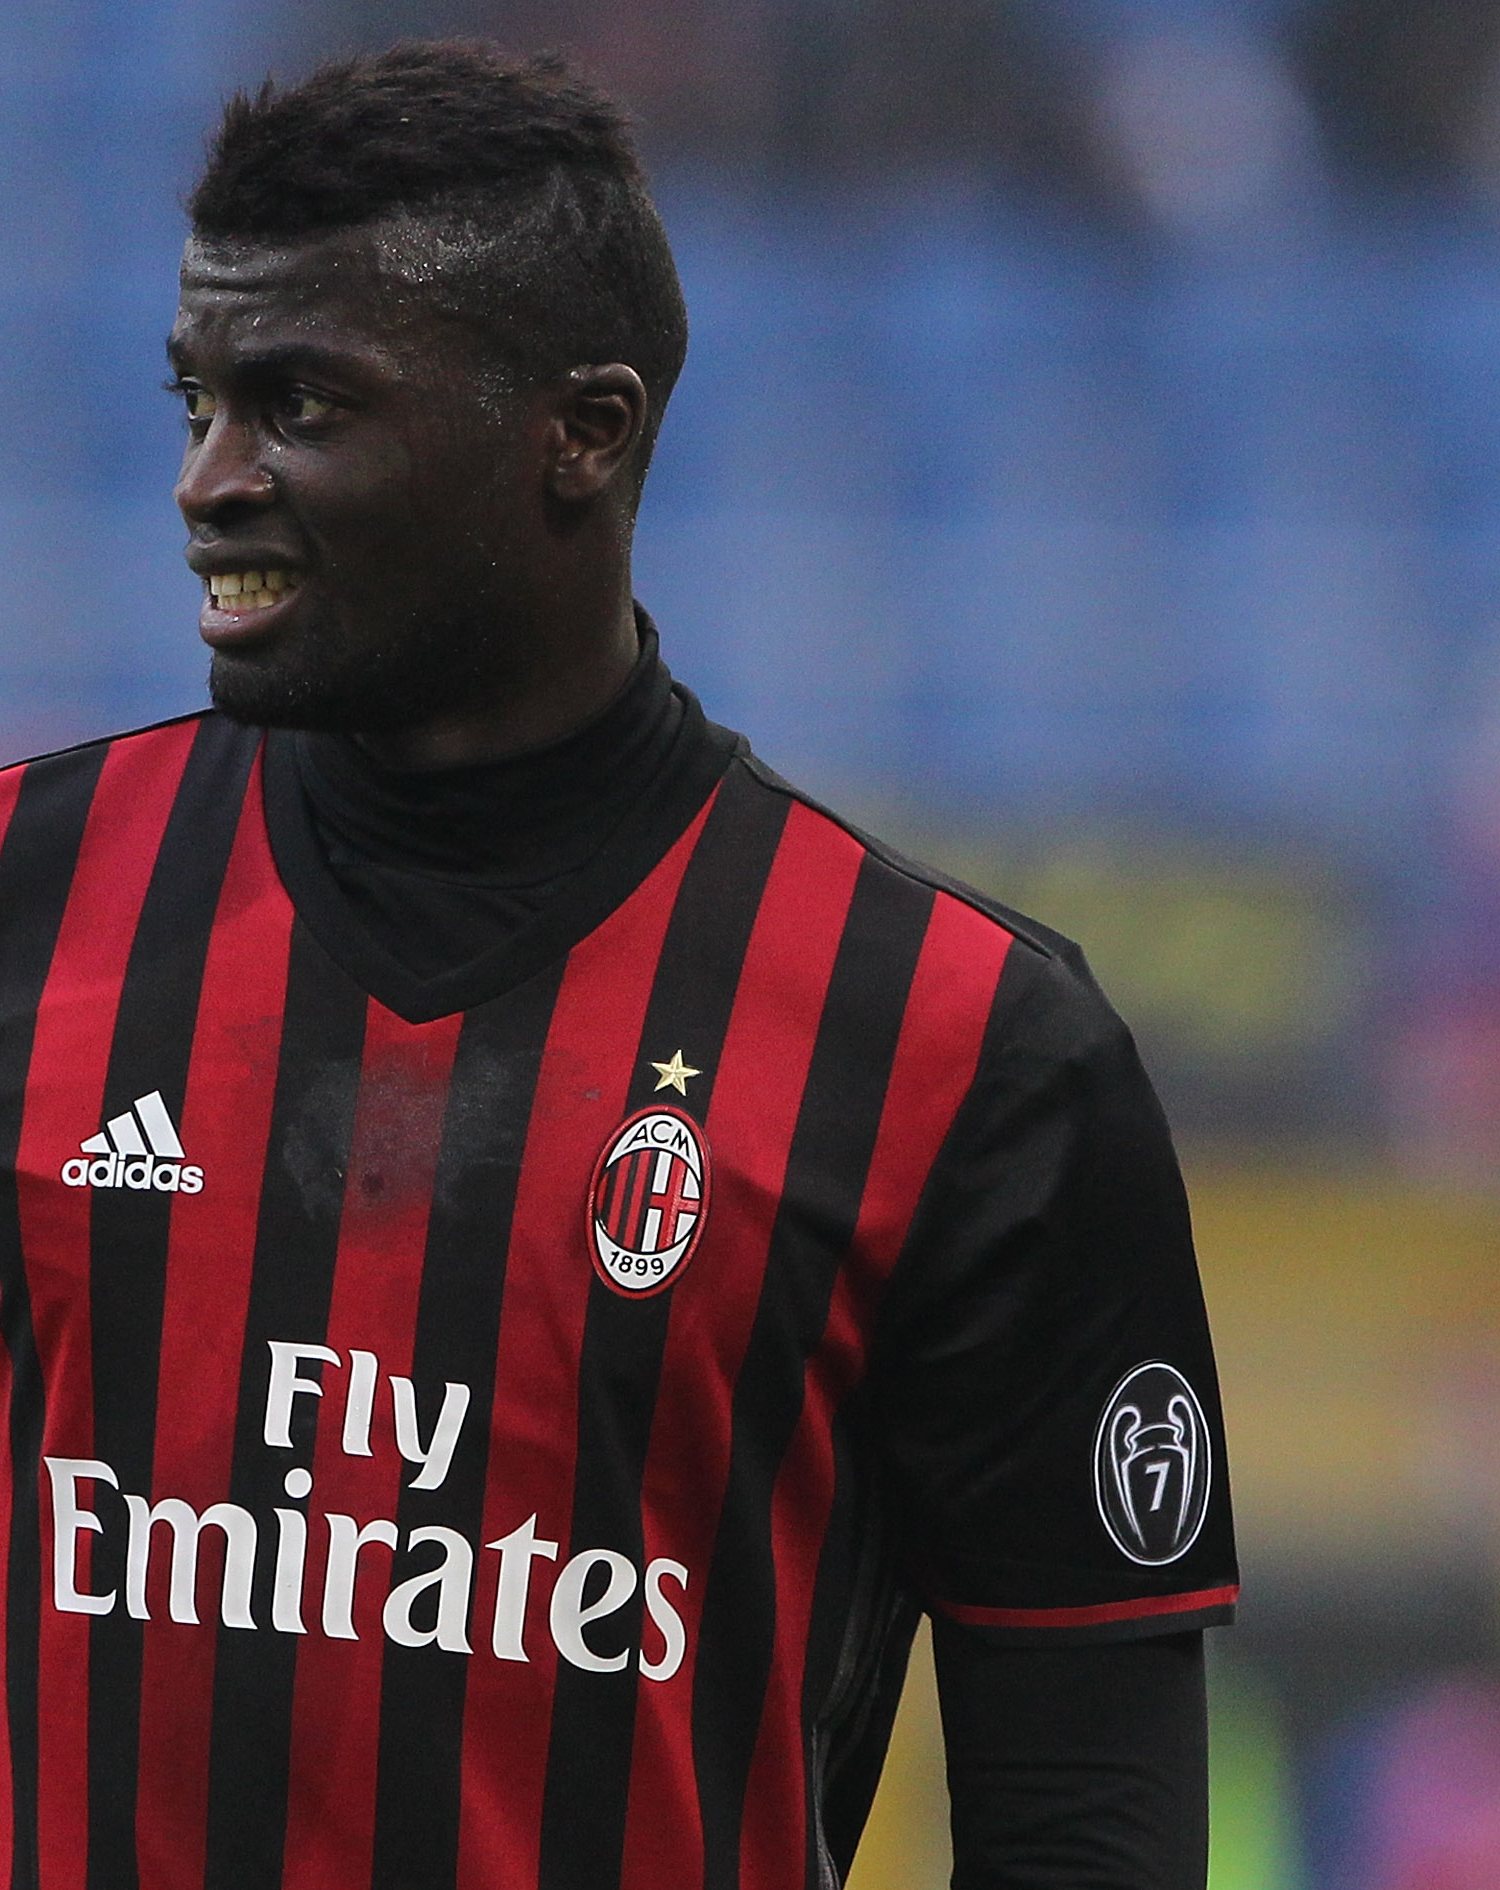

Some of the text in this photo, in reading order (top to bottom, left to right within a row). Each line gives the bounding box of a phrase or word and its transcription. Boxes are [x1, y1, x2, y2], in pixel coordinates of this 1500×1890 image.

[624, 1120, 691, 1158] ACM
[61, 1153, 204, 1194] adidas
[610, 1251, 664, 1276] 1899
[264, 1340, 470, 1490] Fly
[1145, 1462, 1169, 1511] 7
[43, 1457, 689, 1682] Emirates
